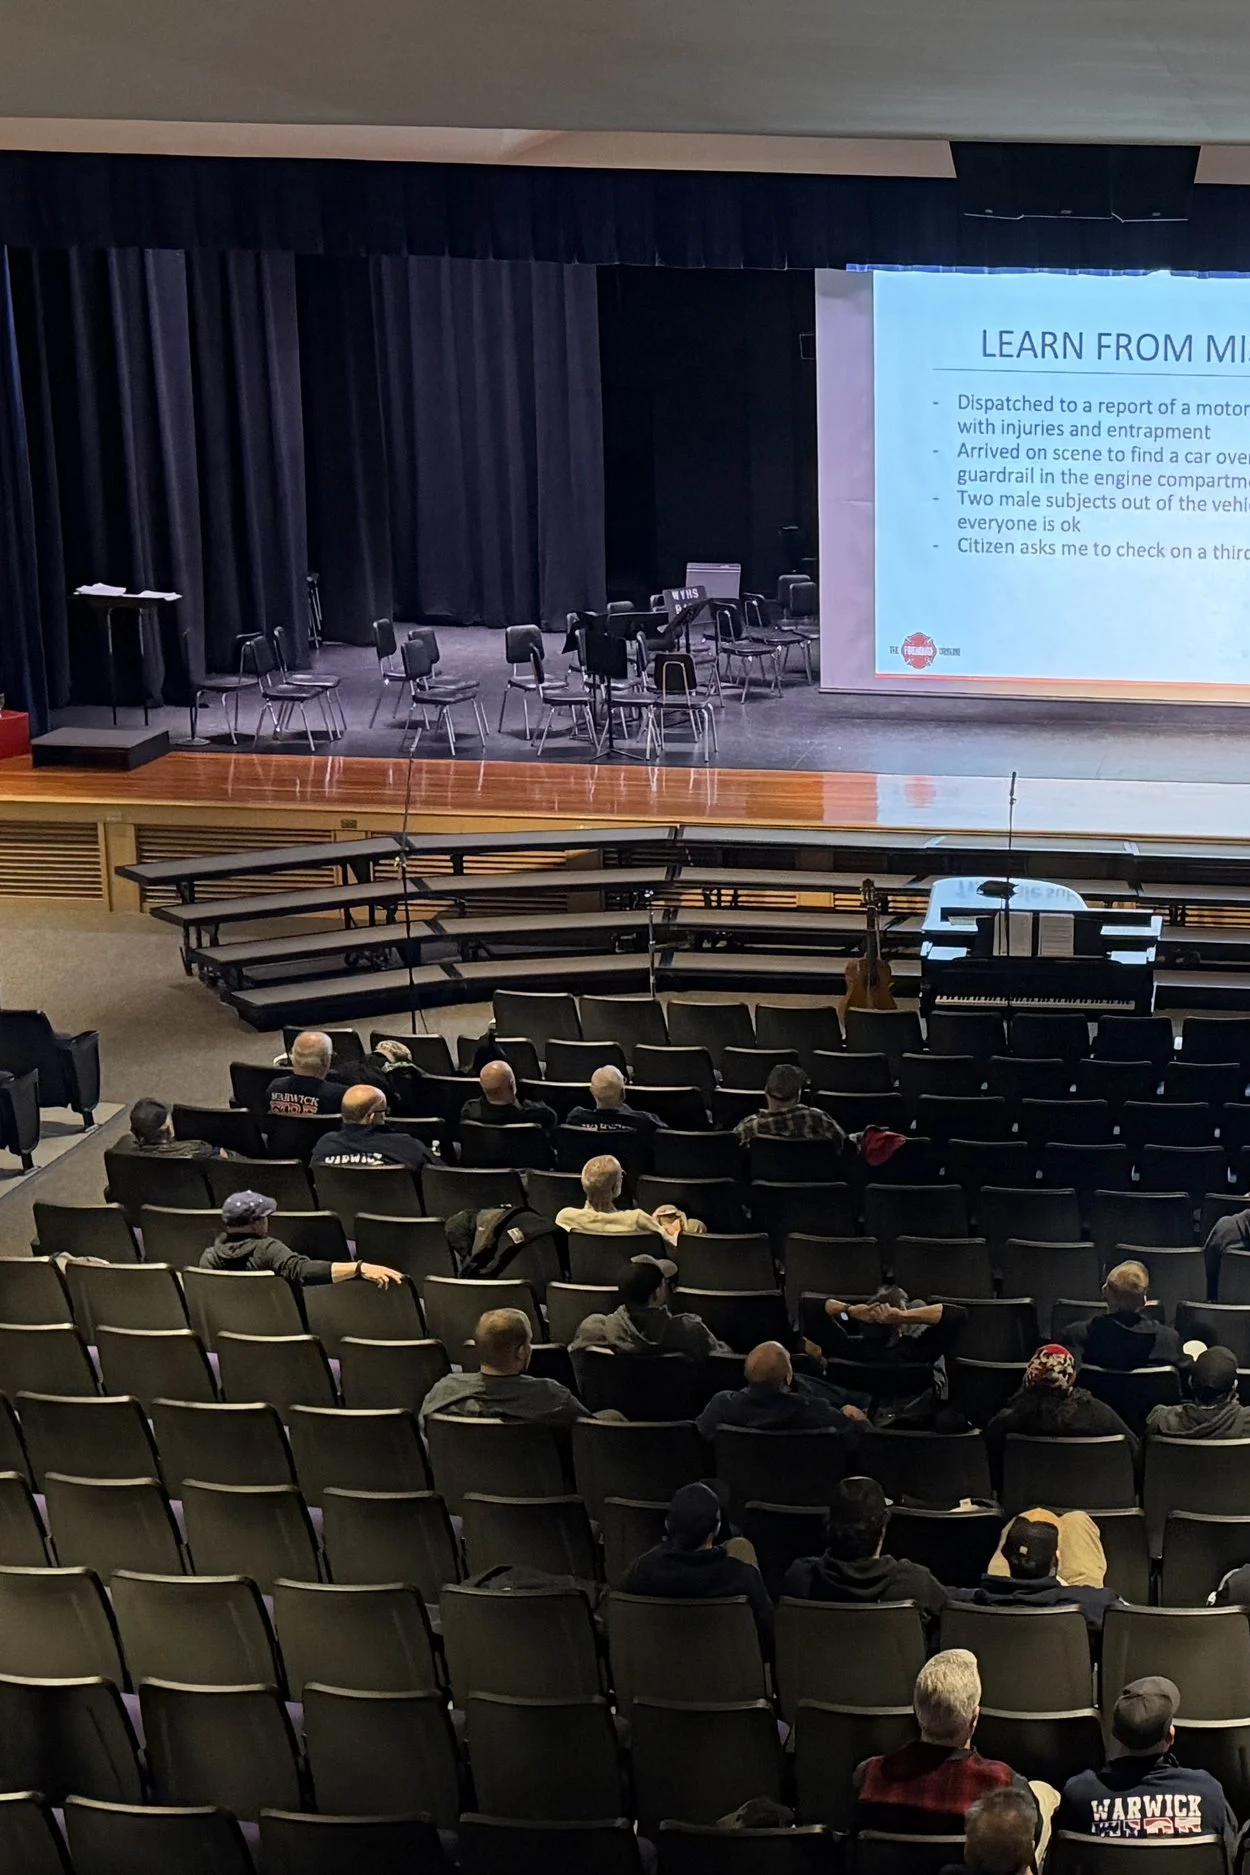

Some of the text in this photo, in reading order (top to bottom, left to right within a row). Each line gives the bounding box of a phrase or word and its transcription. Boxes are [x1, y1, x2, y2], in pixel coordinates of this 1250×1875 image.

[982, 328, 1084, 361] LEARN
[1096, 331, 1193, 363] FROM
[958, 393, 1055, 415] Dispatched
[1058, 396, 1079, 414] to
[1082, 400, 1093, 414] a
[1098, 398, 1154, 419] report
[1157, 397, 1178, 416] of
[1180, 402, 1191, 416] a
[956, 416, 1212, 444] with injuries and entrapment
[956, 441, 1021, 461] Arrived
[1025, 446, 1048, 462] on
[1052, 447, 1105, 463] scene
[1106, 445, 1126, 464] to
[1130, 445, 1164, 465] find
[1168, 450, 1180, 464] a
[1184, 450, 1213, 465] car
[956, 465, 1035, 486] guardrail
[1039, 467, 1055, 485] in
[1059, 466, 1090, 486] the
[1093, 469, 1153, 491] engine
[956, 489, 994, 508] Two
[999, 489, 1042, 509] male
[1045, 490, 1117, 514] subjects
[1121, 494, 1151, 511] out
[1155, 493, 1176, 512] of
[1178, 493, 1208, 513] the
[957, 515, 1081, 536] everyone is ok
[957, 536, 1015, 555] Citizen
[1019, 538, 1057, 556] asks
[1061, 542, 1089, 557] me
[1092, 541, 1112, 558] to
[1115, 540, 1166, 559] check
[1169, 545, 1193, 560] on
[1197, 546, 1208, 561] a
[1091, 1794, 1202, 1822] WARWICK
